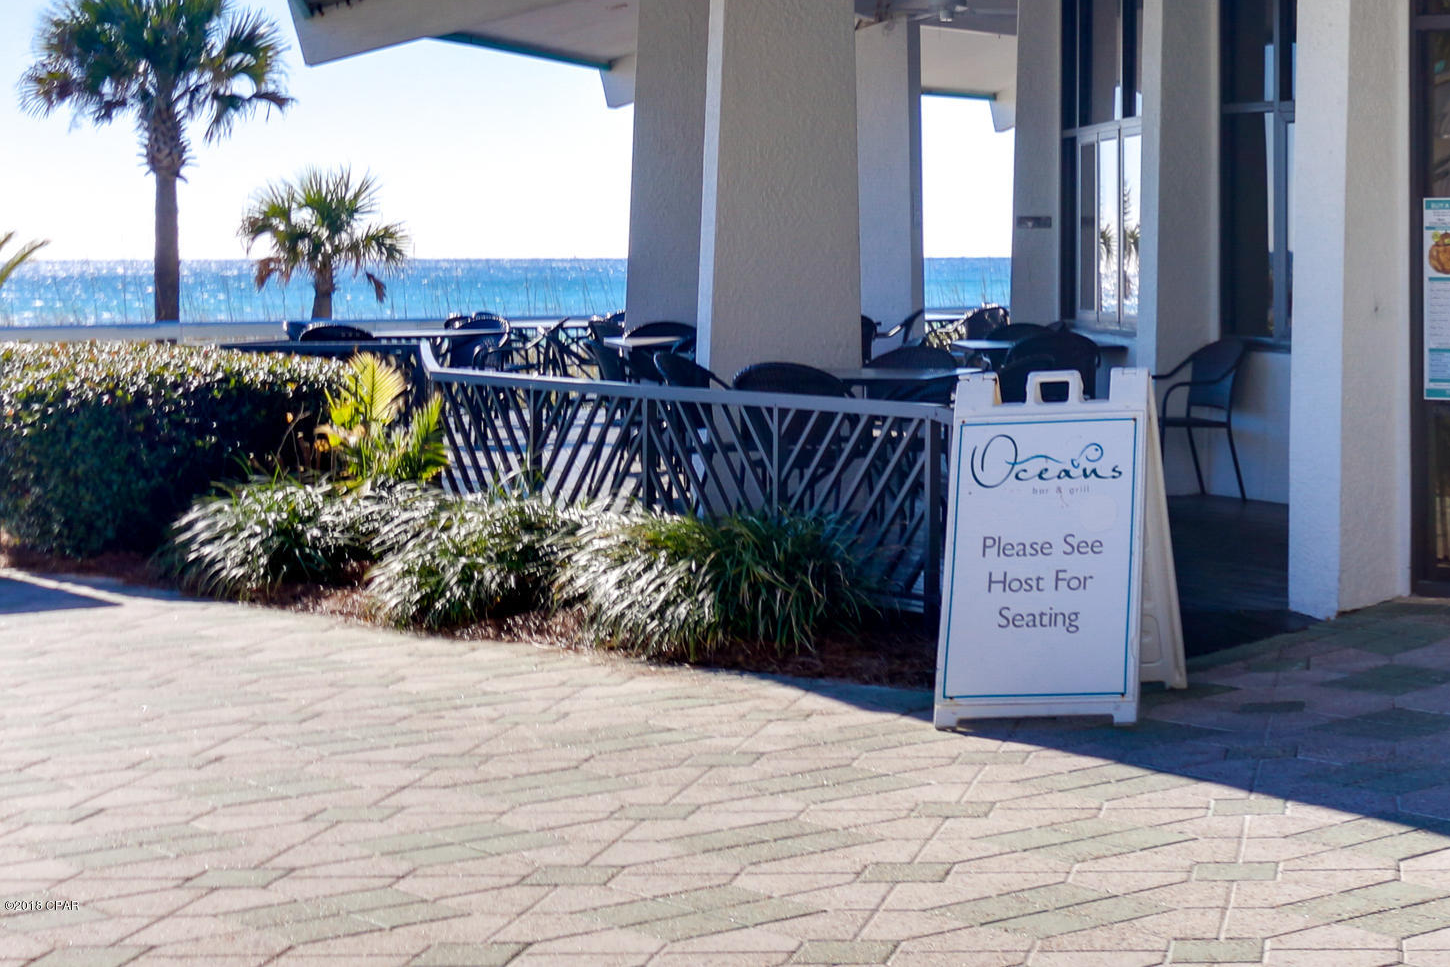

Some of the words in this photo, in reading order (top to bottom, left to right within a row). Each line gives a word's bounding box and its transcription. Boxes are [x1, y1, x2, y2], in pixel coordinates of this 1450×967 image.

[1031, 485, 1050, 496] bar
[1068, 485, 1091, 497] grill
[981, 535, 1054, 559] Please
[1062, 533, 1105, 556] See
[987, 570, 1045, 594] Host
[1055, 569, 1094, 592] For
[997, 605, 1081, 634] Seating
